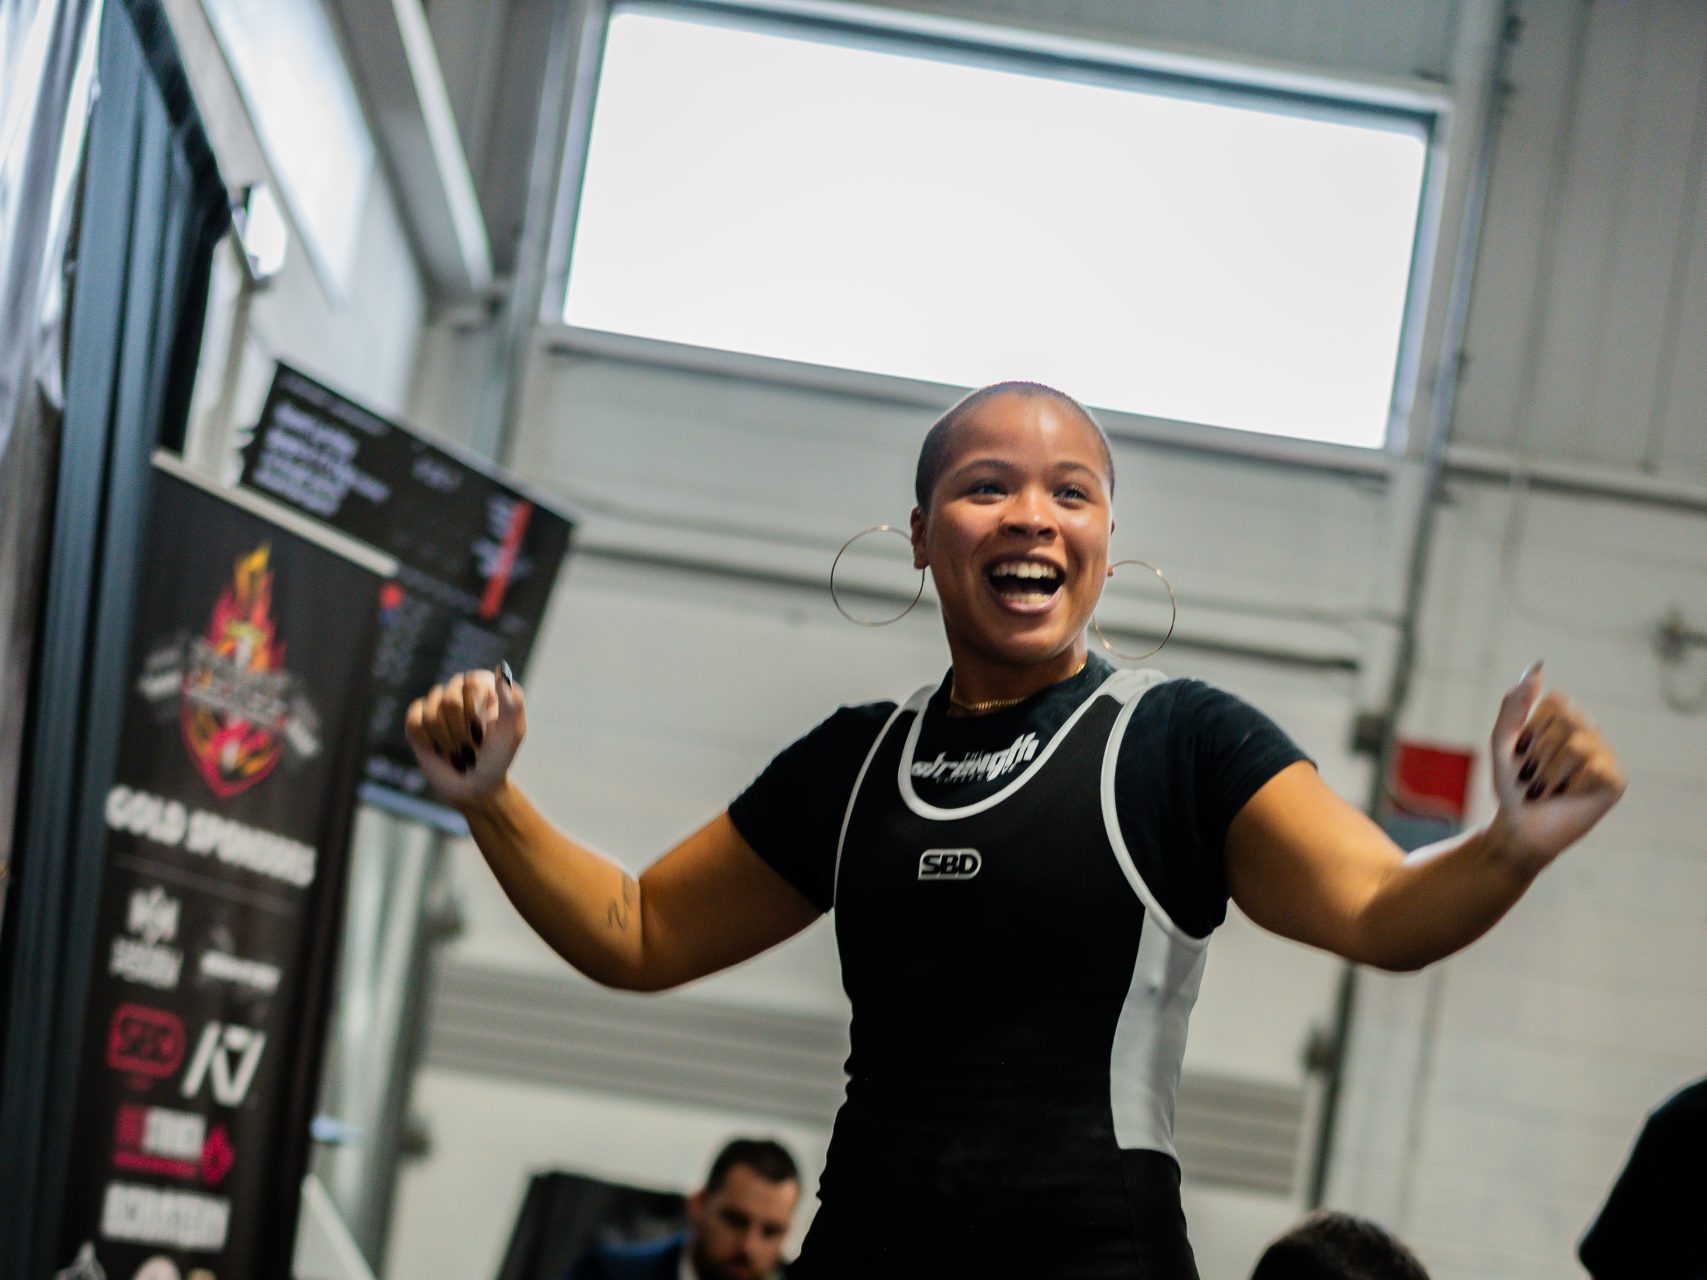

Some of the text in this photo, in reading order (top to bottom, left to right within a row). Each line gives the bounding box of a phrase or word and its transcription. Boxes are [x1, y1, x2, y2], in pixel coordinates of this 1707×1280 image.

[105, 785, 317, 889] GOLD SPONSORS
[920, 852, 979, 877] SBD
